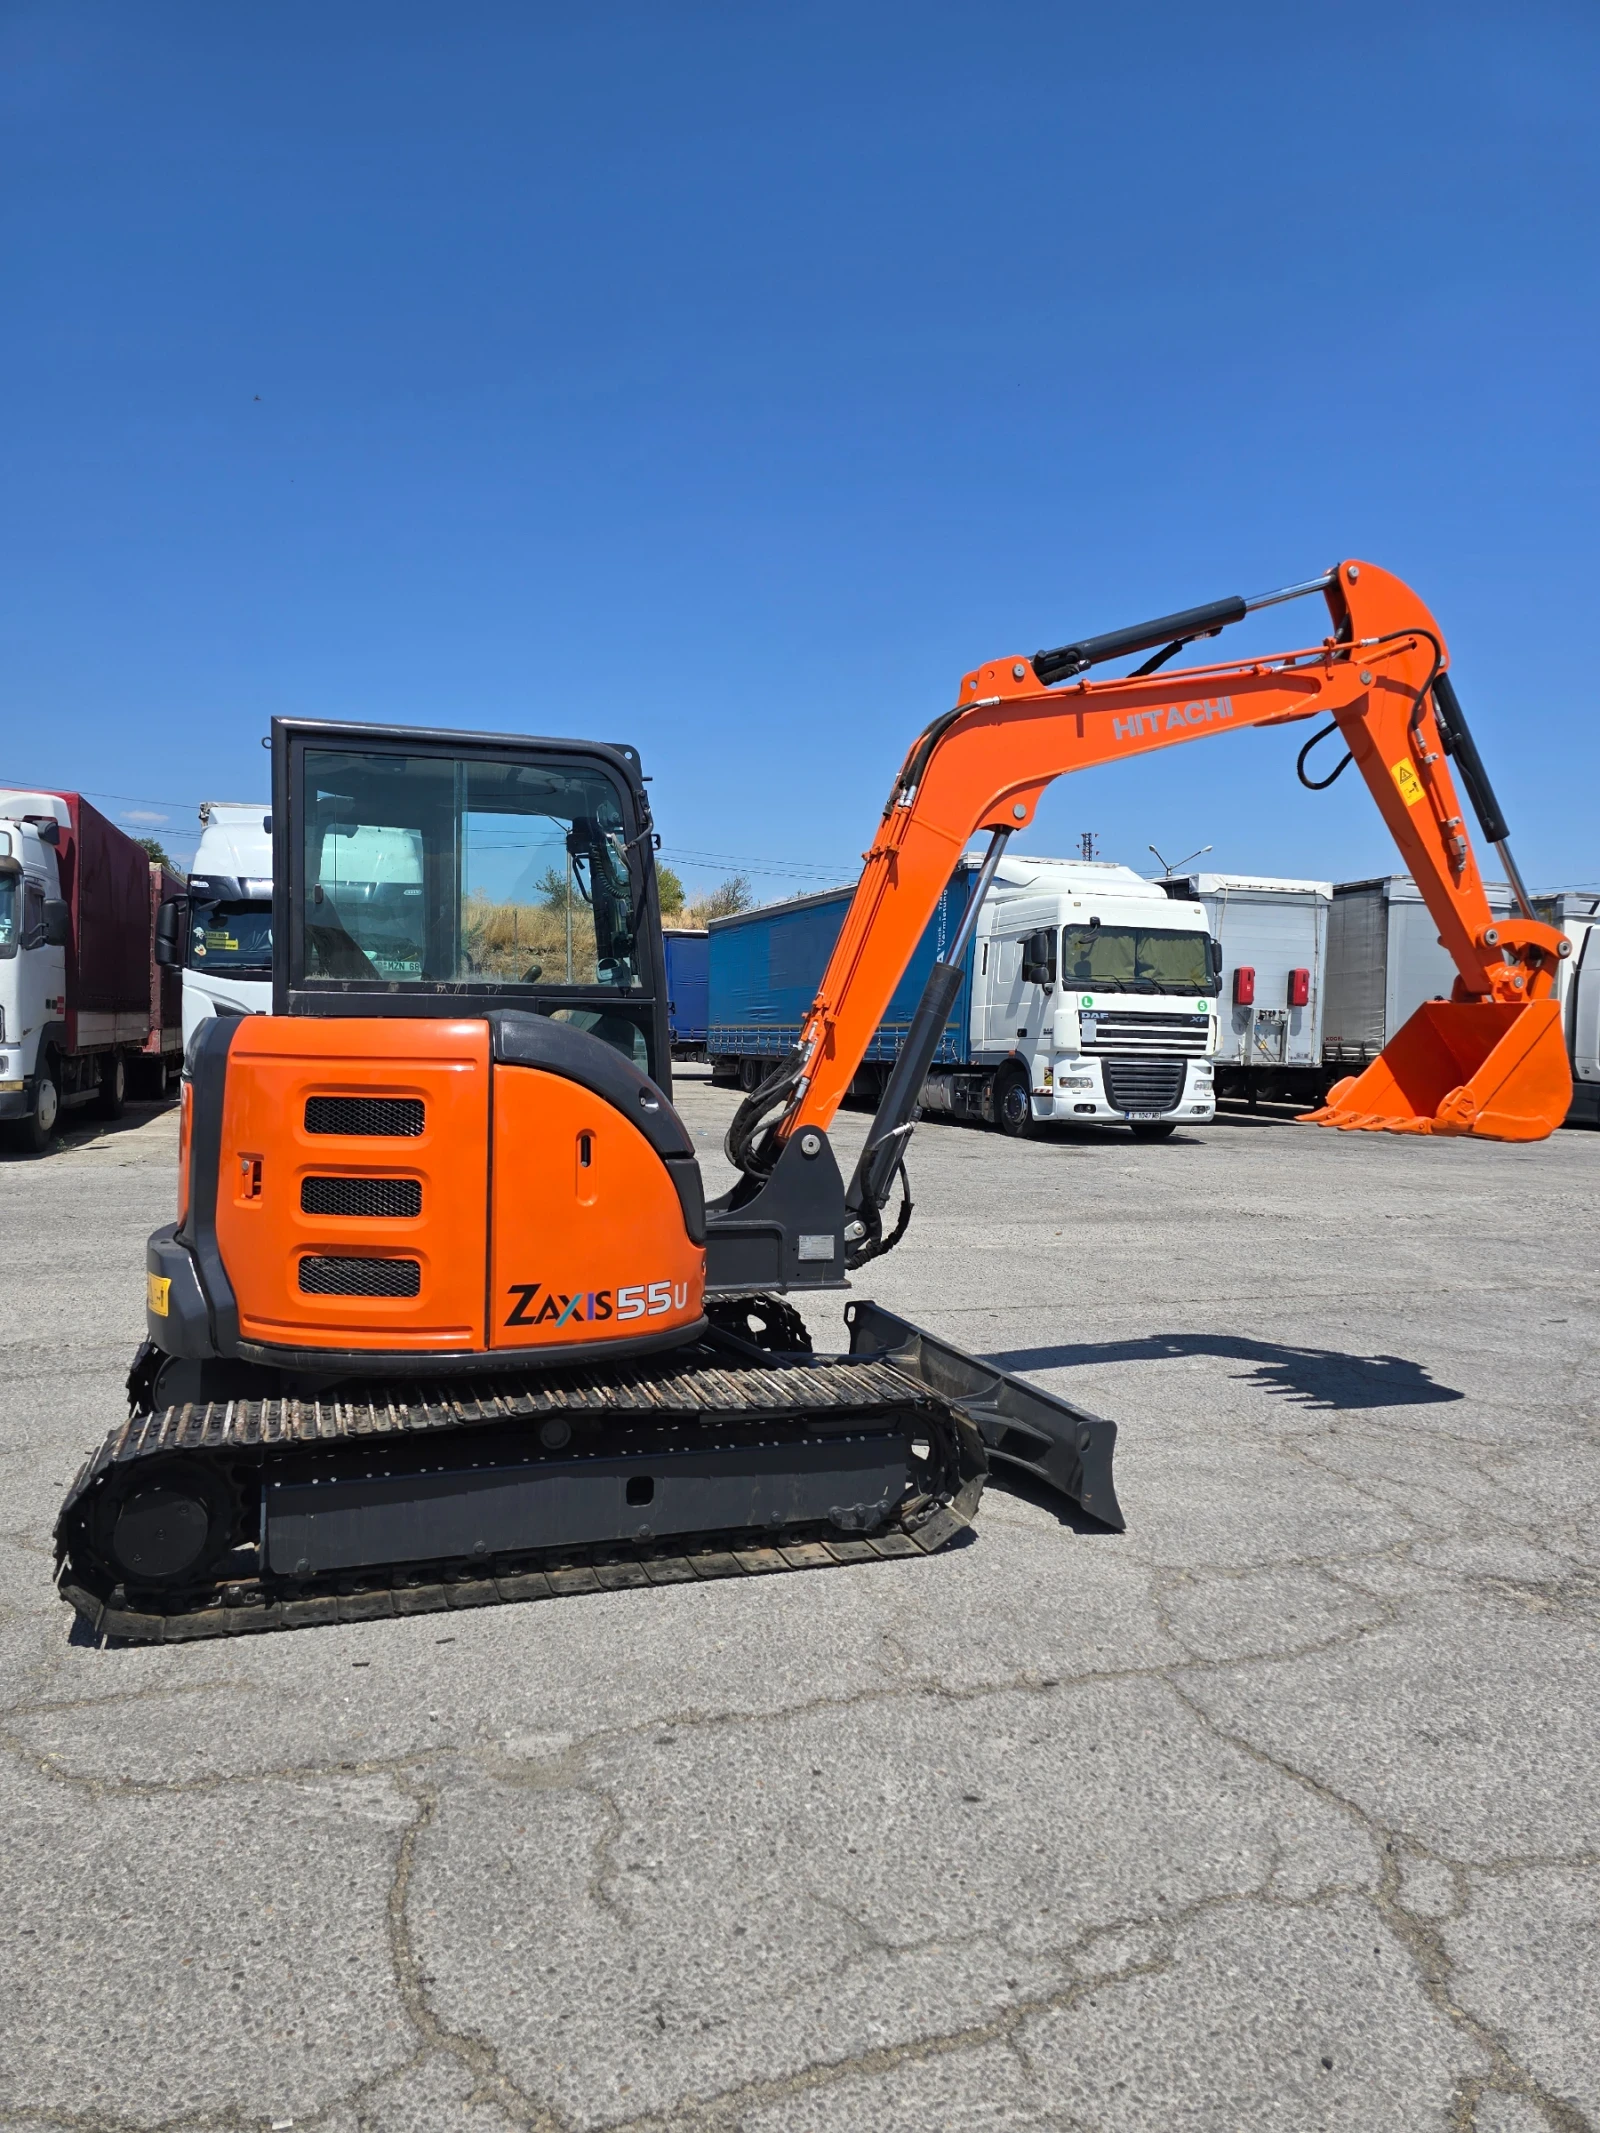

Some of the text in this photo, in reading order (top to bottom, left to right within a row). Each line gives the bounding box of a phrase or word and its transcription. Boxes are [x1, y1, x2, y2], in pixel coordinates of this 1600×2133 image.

[1113, 696, 1233, 740] HITACHI
[388, 962, 405, 970] MZN
[1083, 997, 1091, 1006] L
[1199, 1002, 1205, 1011] 5
[503, 1283, 613, 1327] ZAXIS
